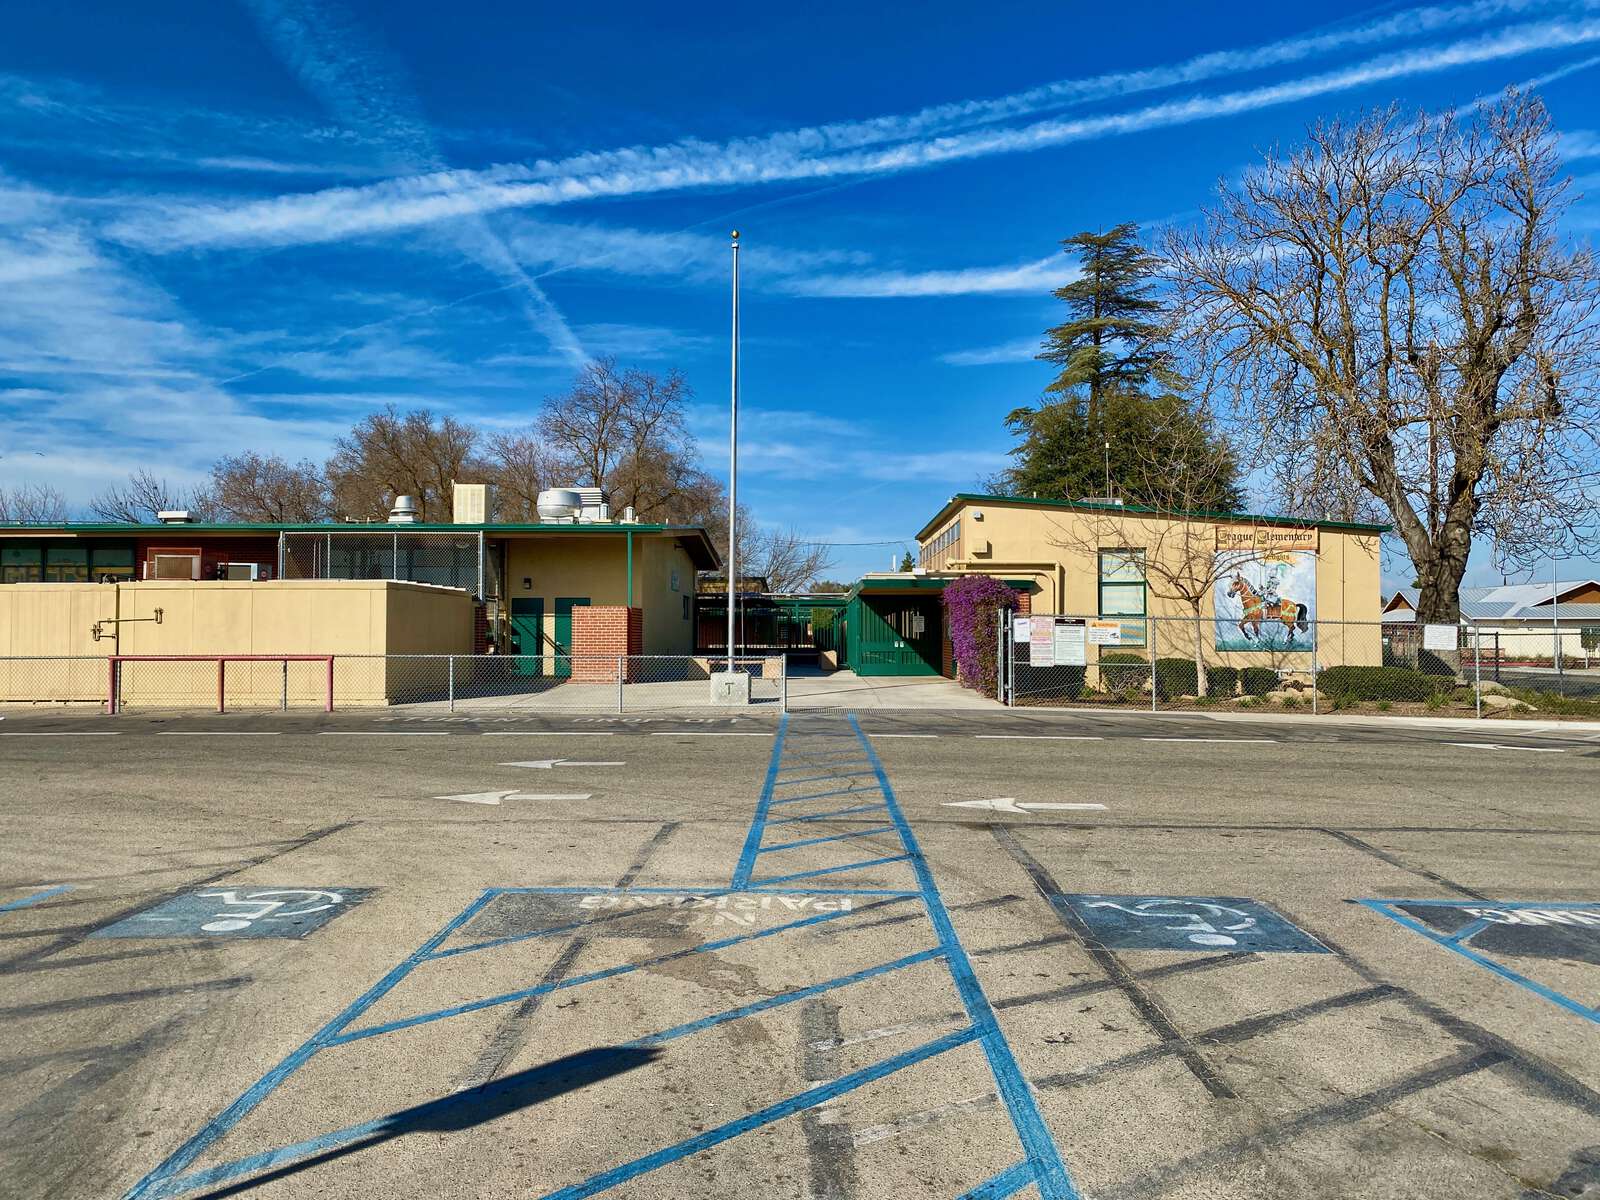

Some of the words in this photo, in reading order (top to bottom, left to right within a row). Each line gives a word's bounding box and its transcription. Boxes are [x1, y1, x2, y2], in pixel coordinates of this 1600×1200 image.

[1257, 530, 1312, 543] Elementary
[725, 682, 735, 695] T
[579, 895, 853, 911] PARKING
